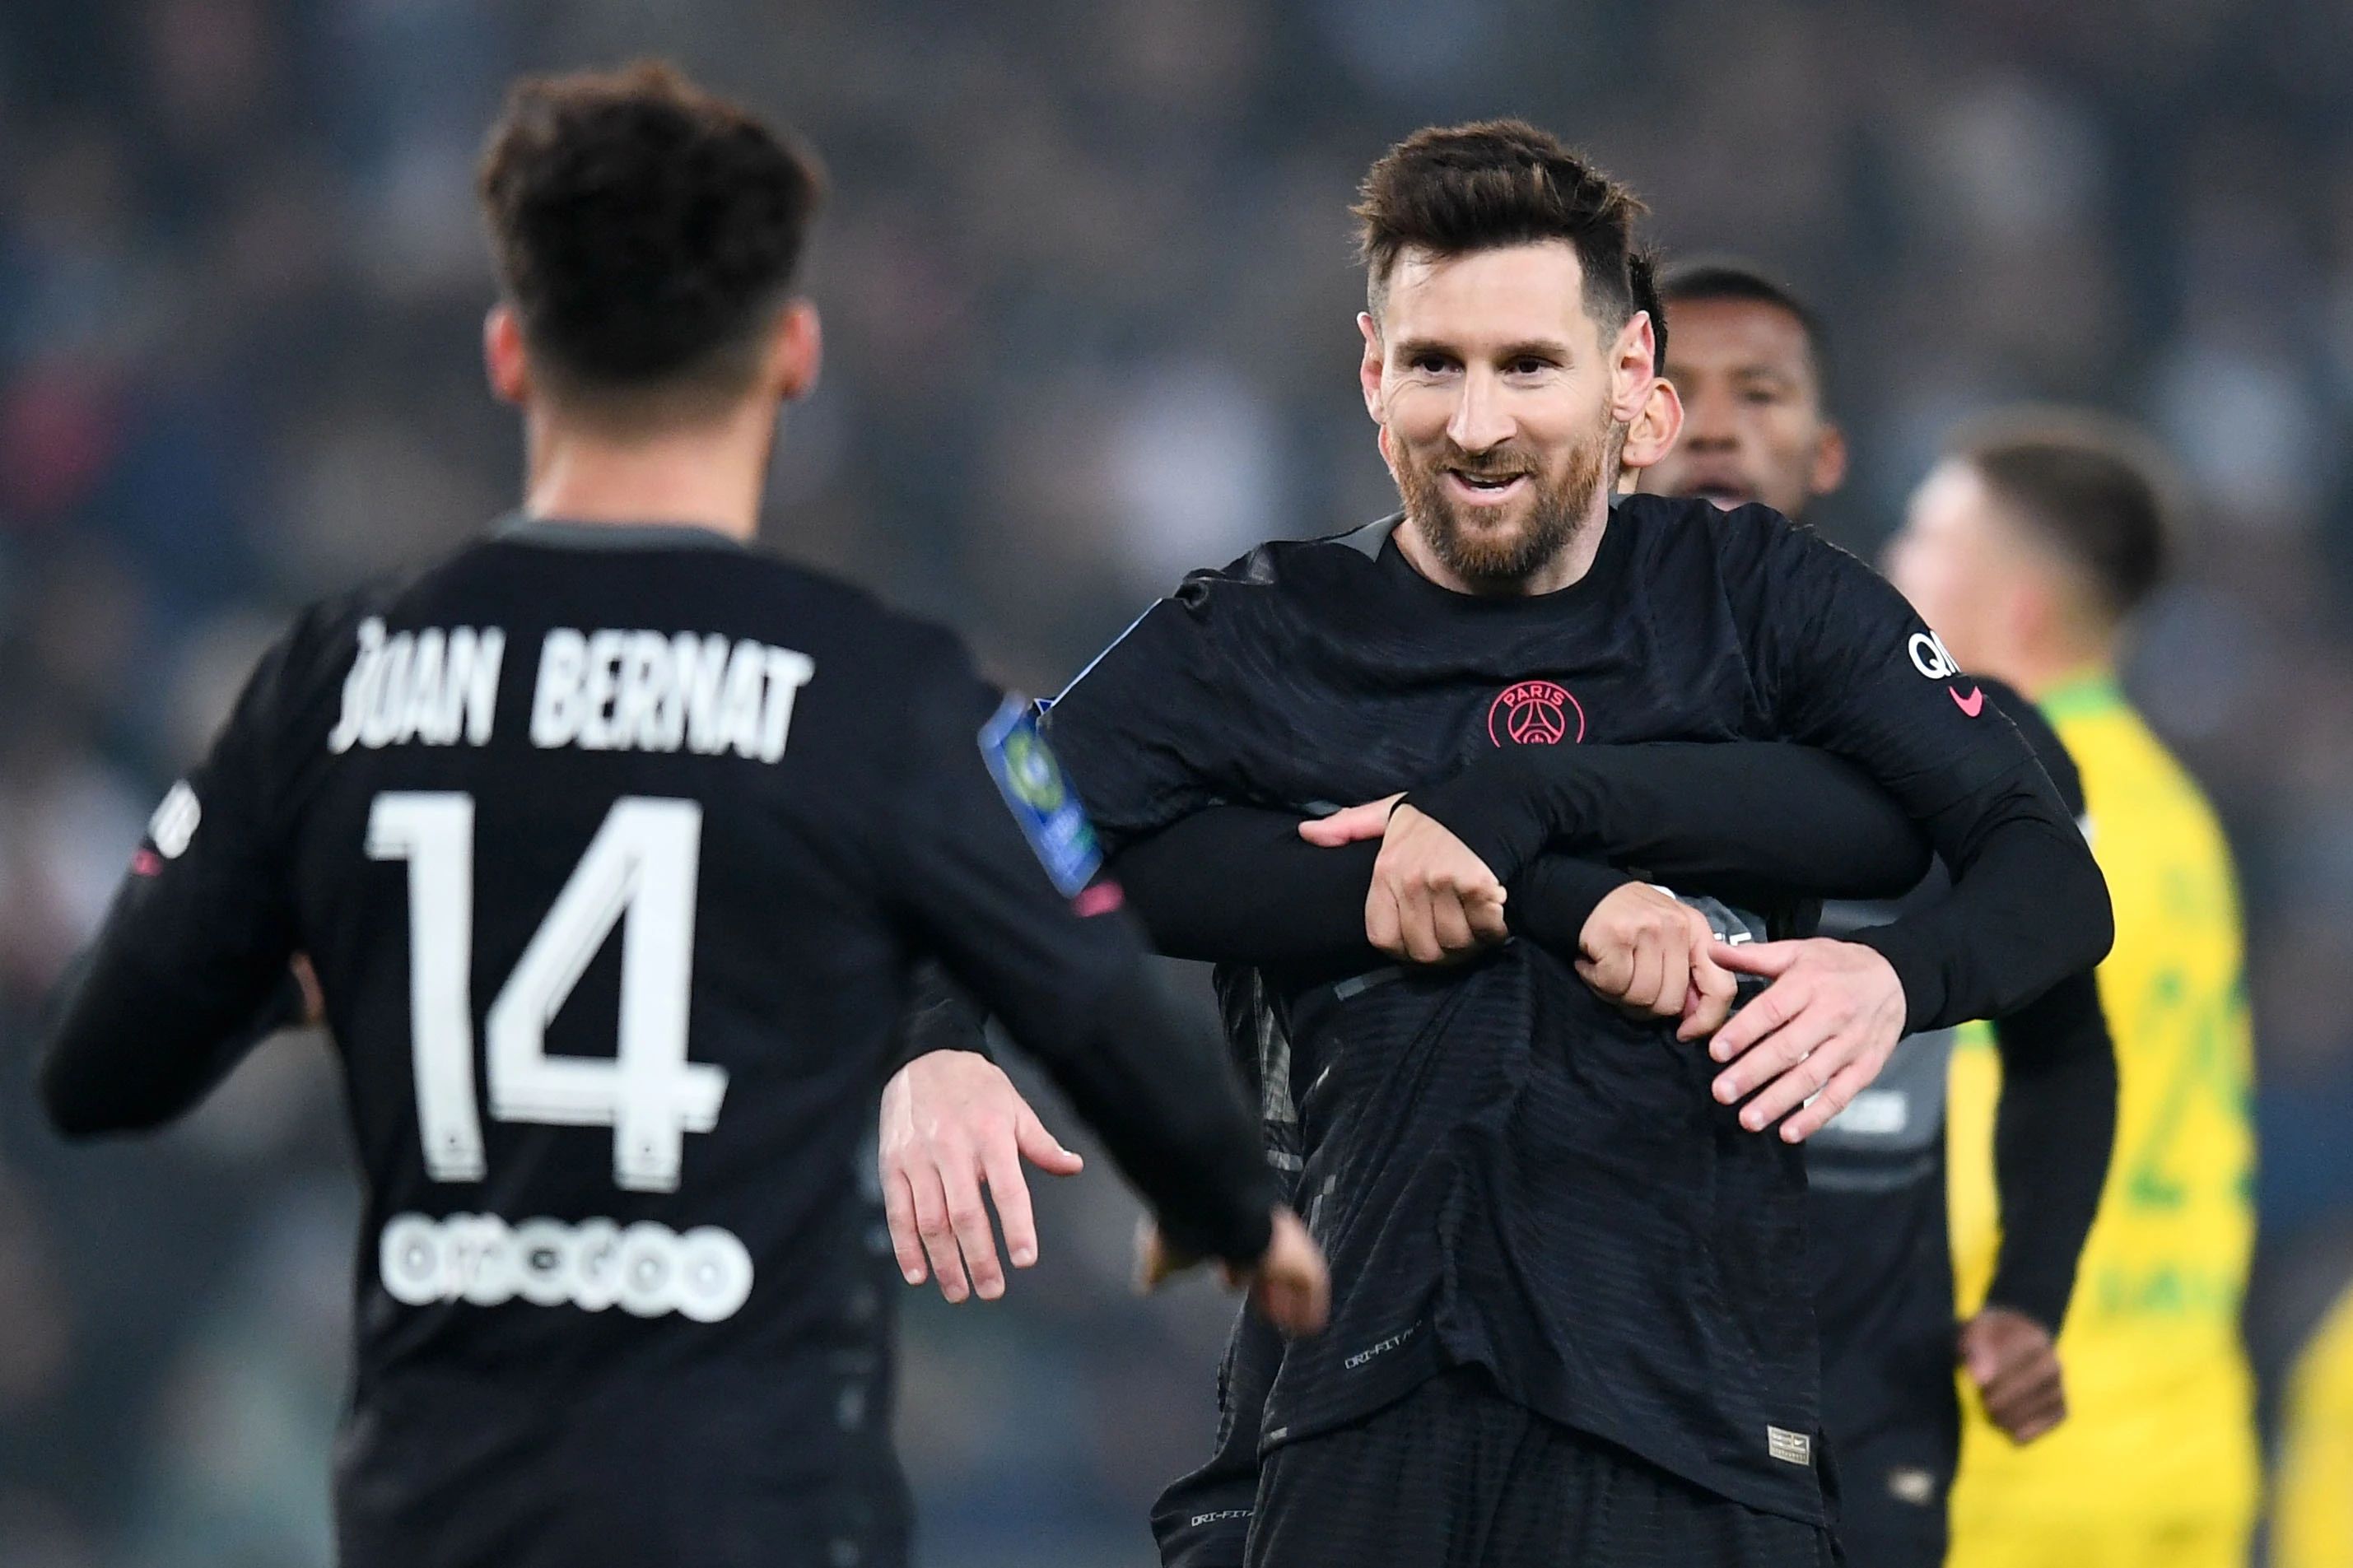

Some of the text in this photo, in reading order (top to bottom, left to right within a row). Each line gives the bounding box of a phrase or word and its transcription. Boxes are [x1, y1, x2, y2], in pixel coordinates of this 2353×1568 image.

[329, 616, 815, 764] JUAN BERNAT
[1503, 685, 1565, 707] PARIS
[364, 791, 729, 1193] 14
[1344, 1335, 1400, 1370] DRI-FIT
